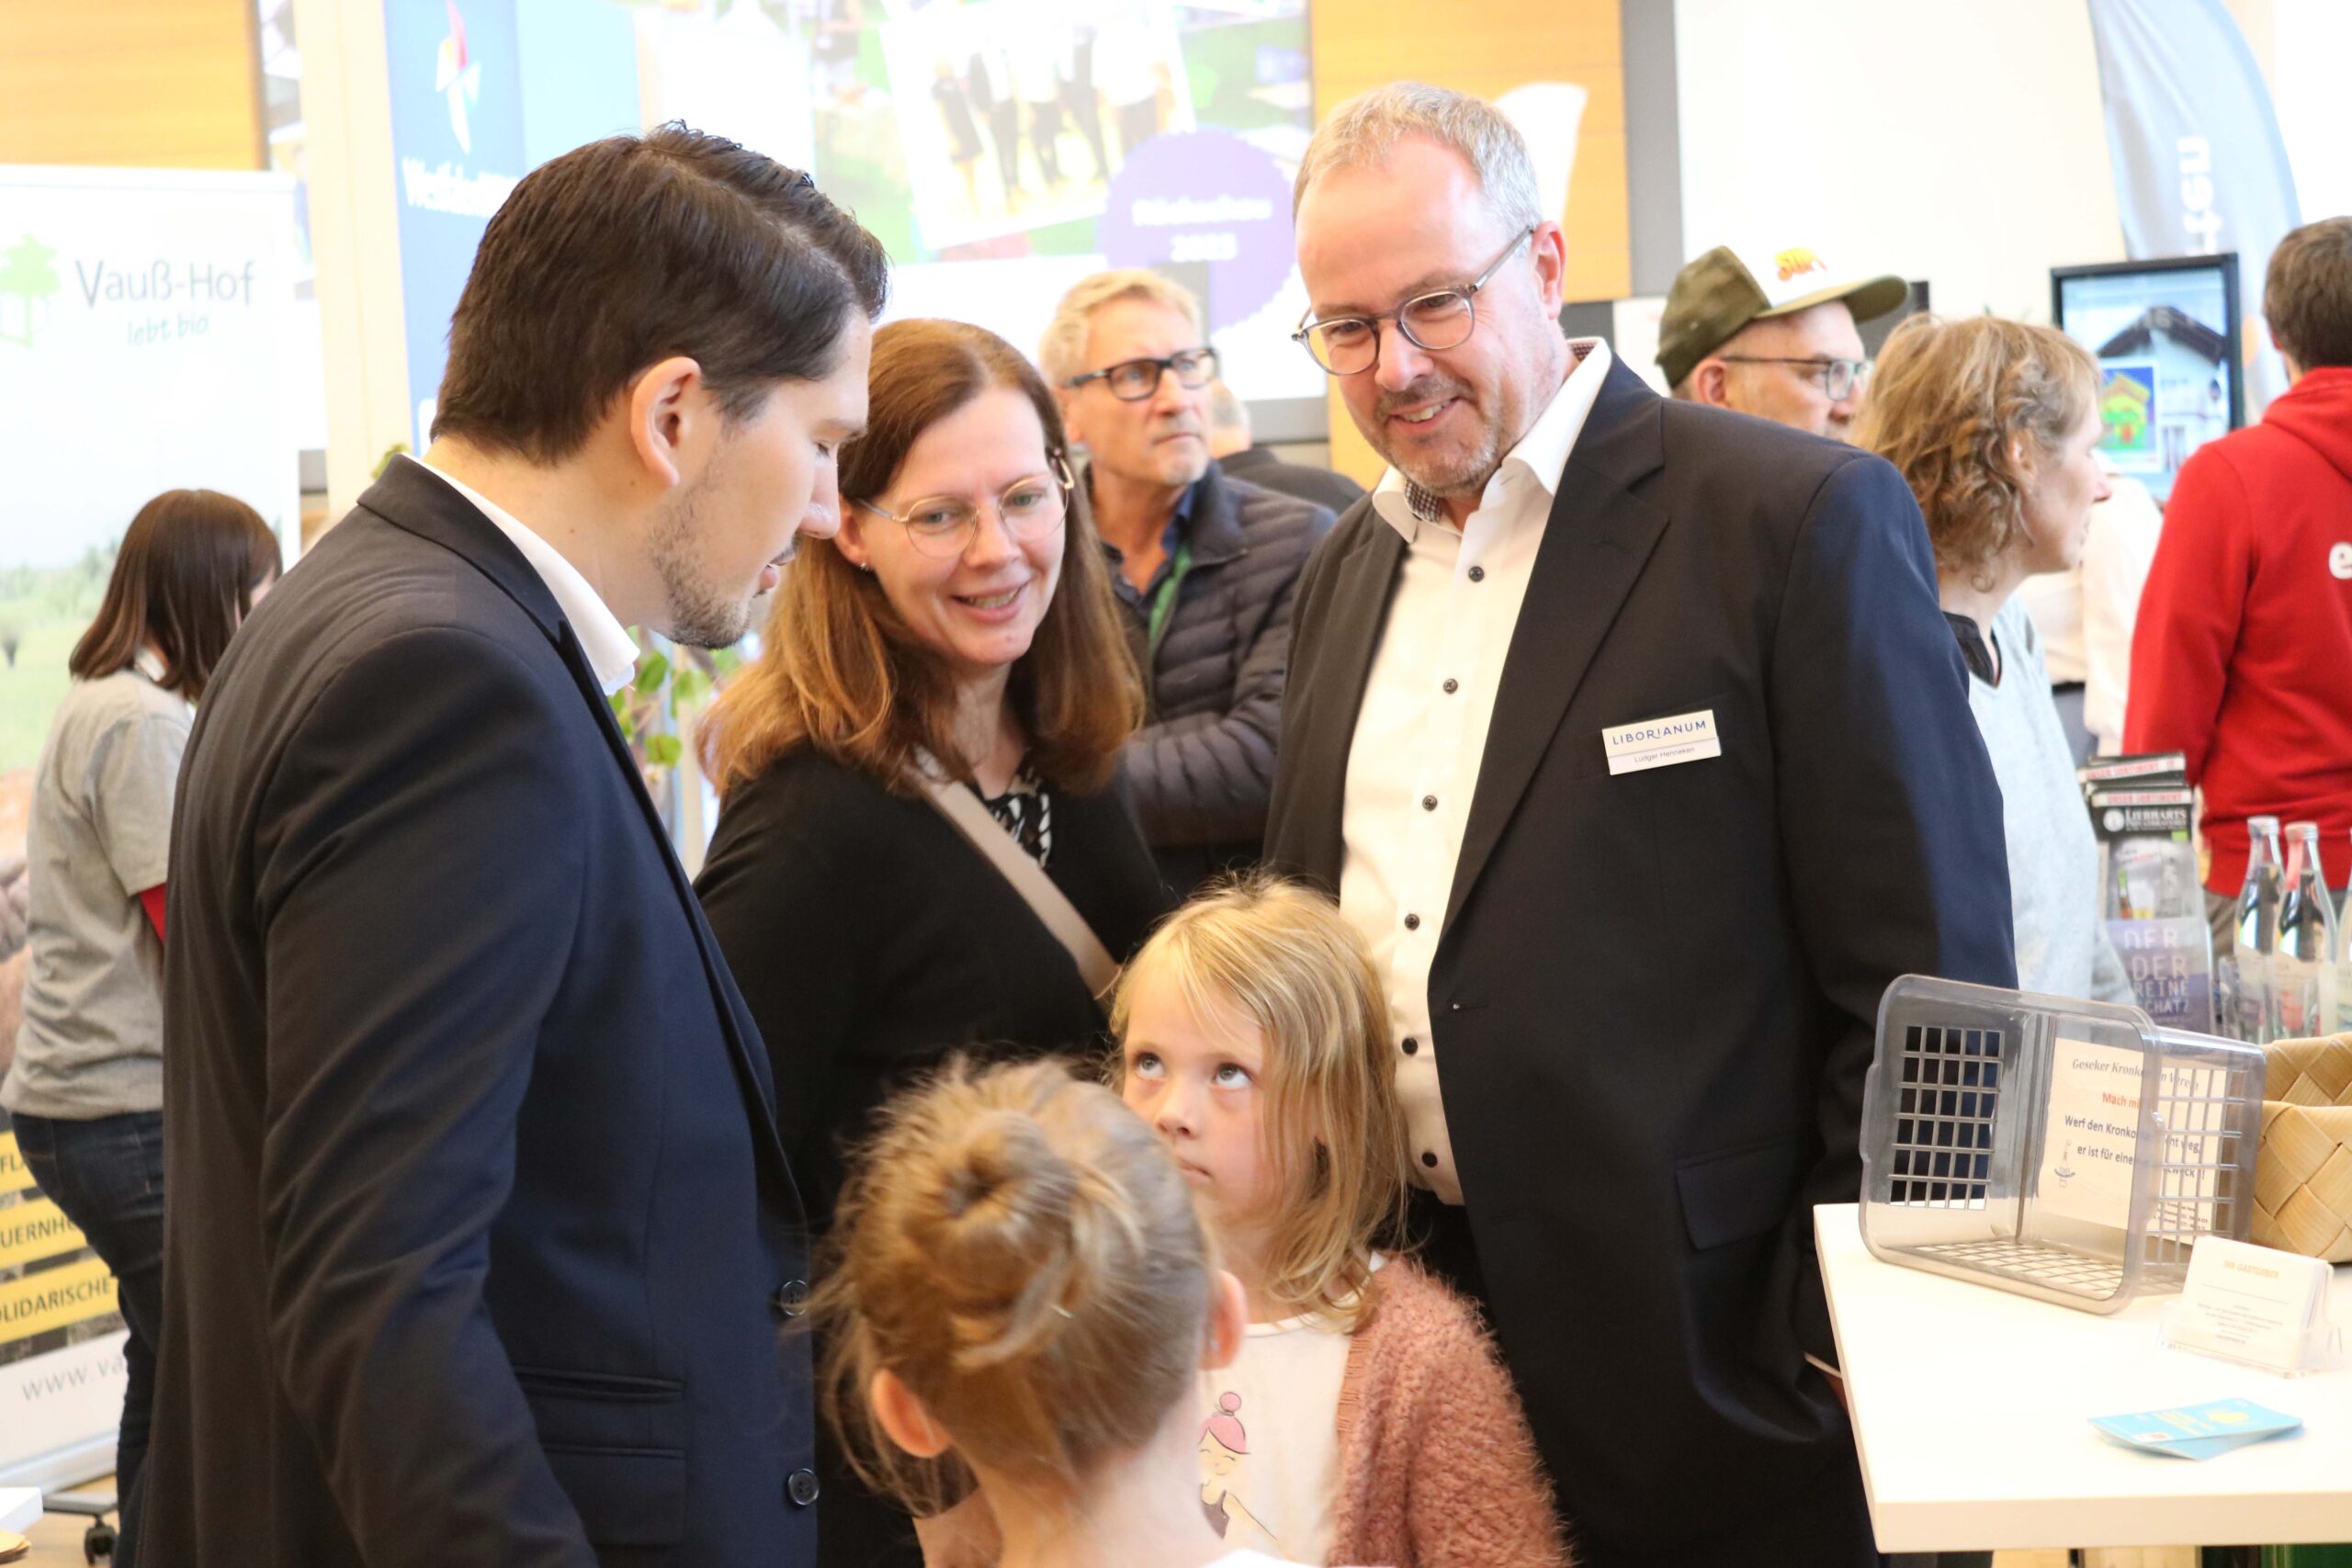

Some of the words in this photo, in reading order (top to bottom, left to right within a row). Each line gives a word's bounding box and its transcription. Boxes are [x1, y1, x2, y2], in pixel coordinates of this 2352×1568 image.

[75, 258, 255, 309] Vauß-Hof
[127, 318, 170, 347] lebt
[177, 310, 209, 338] bio
[1612, 720, 1706, 745] LIBORIANUM
[1634, 753, 1659, 763] Ludger
[1660, 747, 1695, 758] Henneken
[2132, 955, 2188, 981] DER
[2141, 998, 2188, 1014] CHATZ
[2073, 1058, 2110, 1072] Geseker
[2102, 1092, 2126, 1108] Mach
[2129, 1098, 2141, 1110] mi
[2064, 1115, 2086, 1130] Werf
[2087, 1120, 2104, 1133] den
[2076, 1145, 2086, 1155] er
[2088, 1145, 2099, 1158] ist
[2100, 1148, 2113, 1162] für
[0, 1277, 111, 1324] LIDARISCHE
